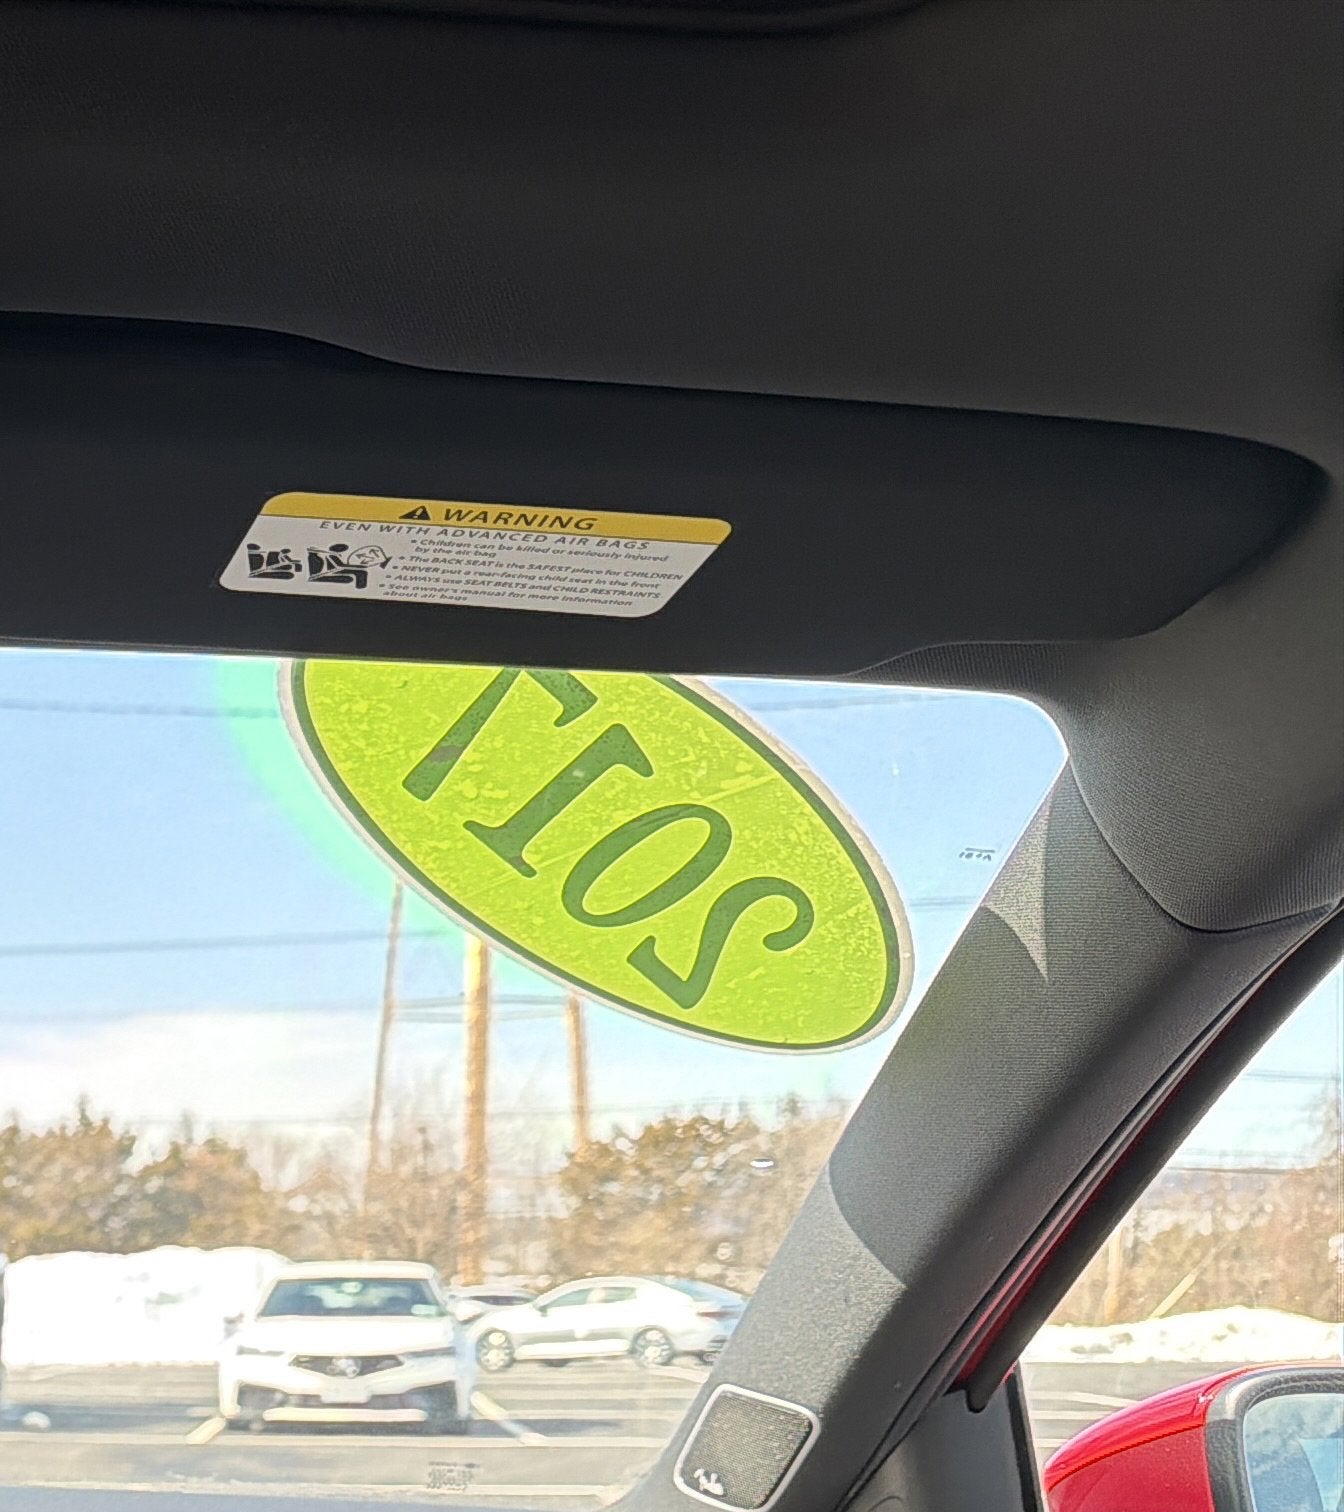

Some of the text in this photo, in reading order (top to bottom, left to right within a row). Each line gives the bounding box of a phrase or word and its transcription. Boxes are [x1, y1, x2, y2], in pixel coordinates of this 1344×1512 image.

[443, 508, 599, 531] WARNING
[318, 520, 651, 550] EVEN WITH ADVANCED AIR BAGS
[414, 546, 431, 554] by
[473, 550, 498, 559] bag
[418, 539, 472, 549] Children
[515, 545, 551, 554] killed
[567, 549, 623, 560] seriously
[622, 552, 670, 563] injured
[400, 566, 442, 574] NEVER
[537, 574, 569, 582] child
[568, 576, 595, 584] seat
[630, 580, 661, 588] front
[409, 556, 433, 564] The
[432, 558, 465, 566] BACK
[464, 560, 495, 568] SEAT
[505, 562, 526, 570] the
[527, 564, 572, 572] SAFEST
[571, 567, 604, 576] place
[623, 570, 684, 581] CHILDREN
[393, 575, 442, 584] ALWAYS
[463, 579, 494, 587] SEAT
[493, 581, 529, 590] BELTS
[528, 583, 553, 591] and
[552, 585, 590, 594] CHILD
[589, 587, 662, 598] RESTRAINTS
[461, 589, 507, 598] manual
[561, 595, 633, 606] information
